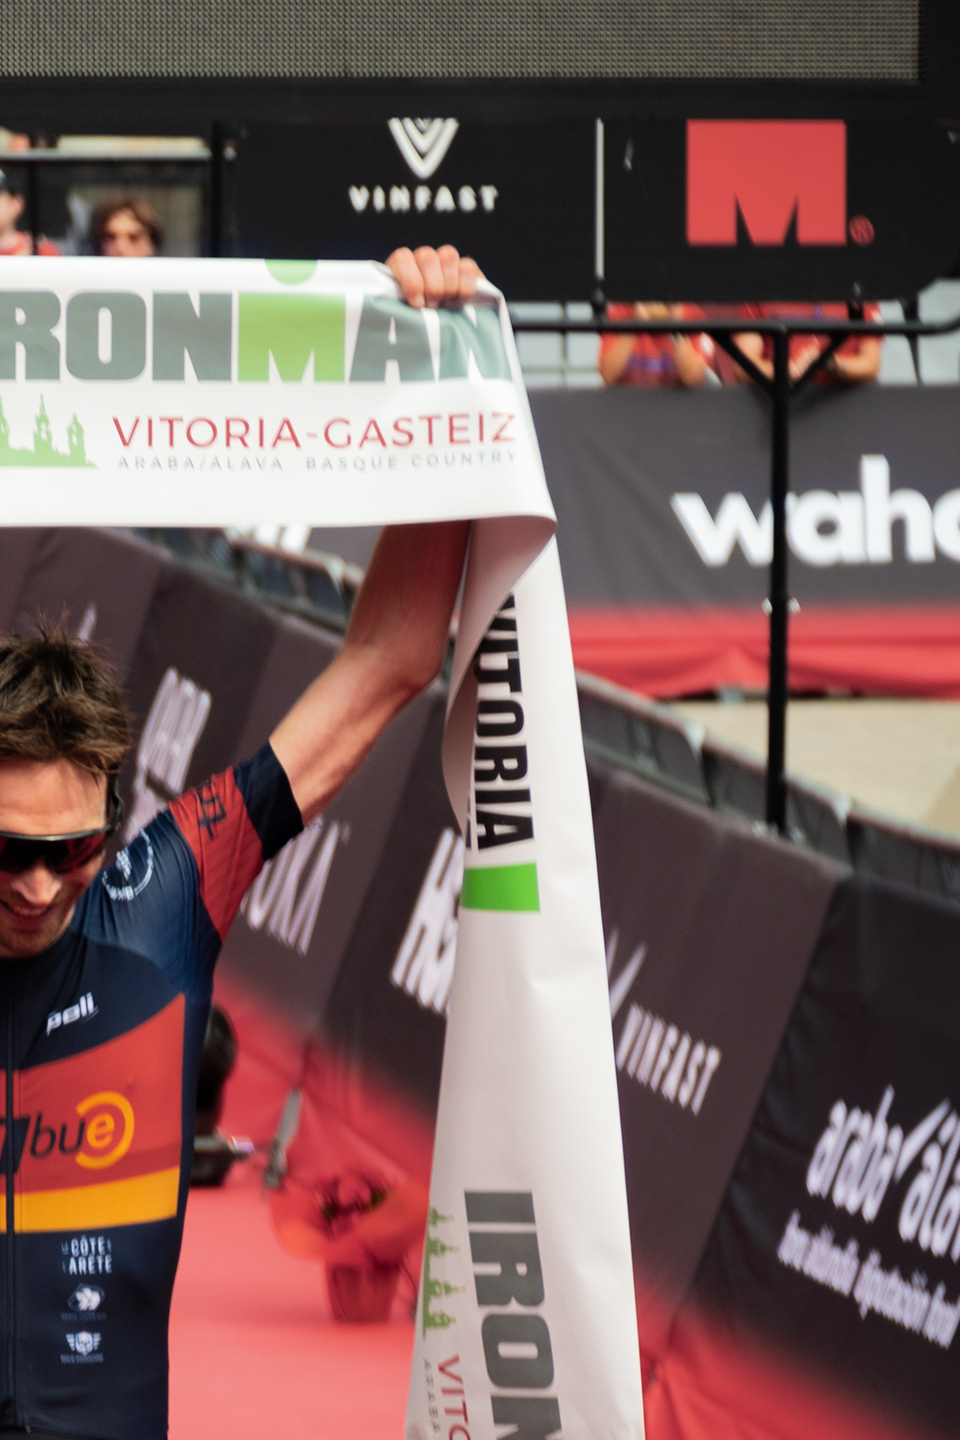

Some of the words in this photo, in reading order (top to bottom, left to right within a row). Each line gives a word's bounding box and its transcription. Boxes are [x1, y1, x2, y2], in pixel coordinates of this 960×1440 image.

[348, 184, 499, 213] VINFAST
[112, 412, 517, 450] VITORIA-GASTEIZ
[305, 456, 400, 473] BASQUE
[410, 449, 518, 470] COUNTRY
